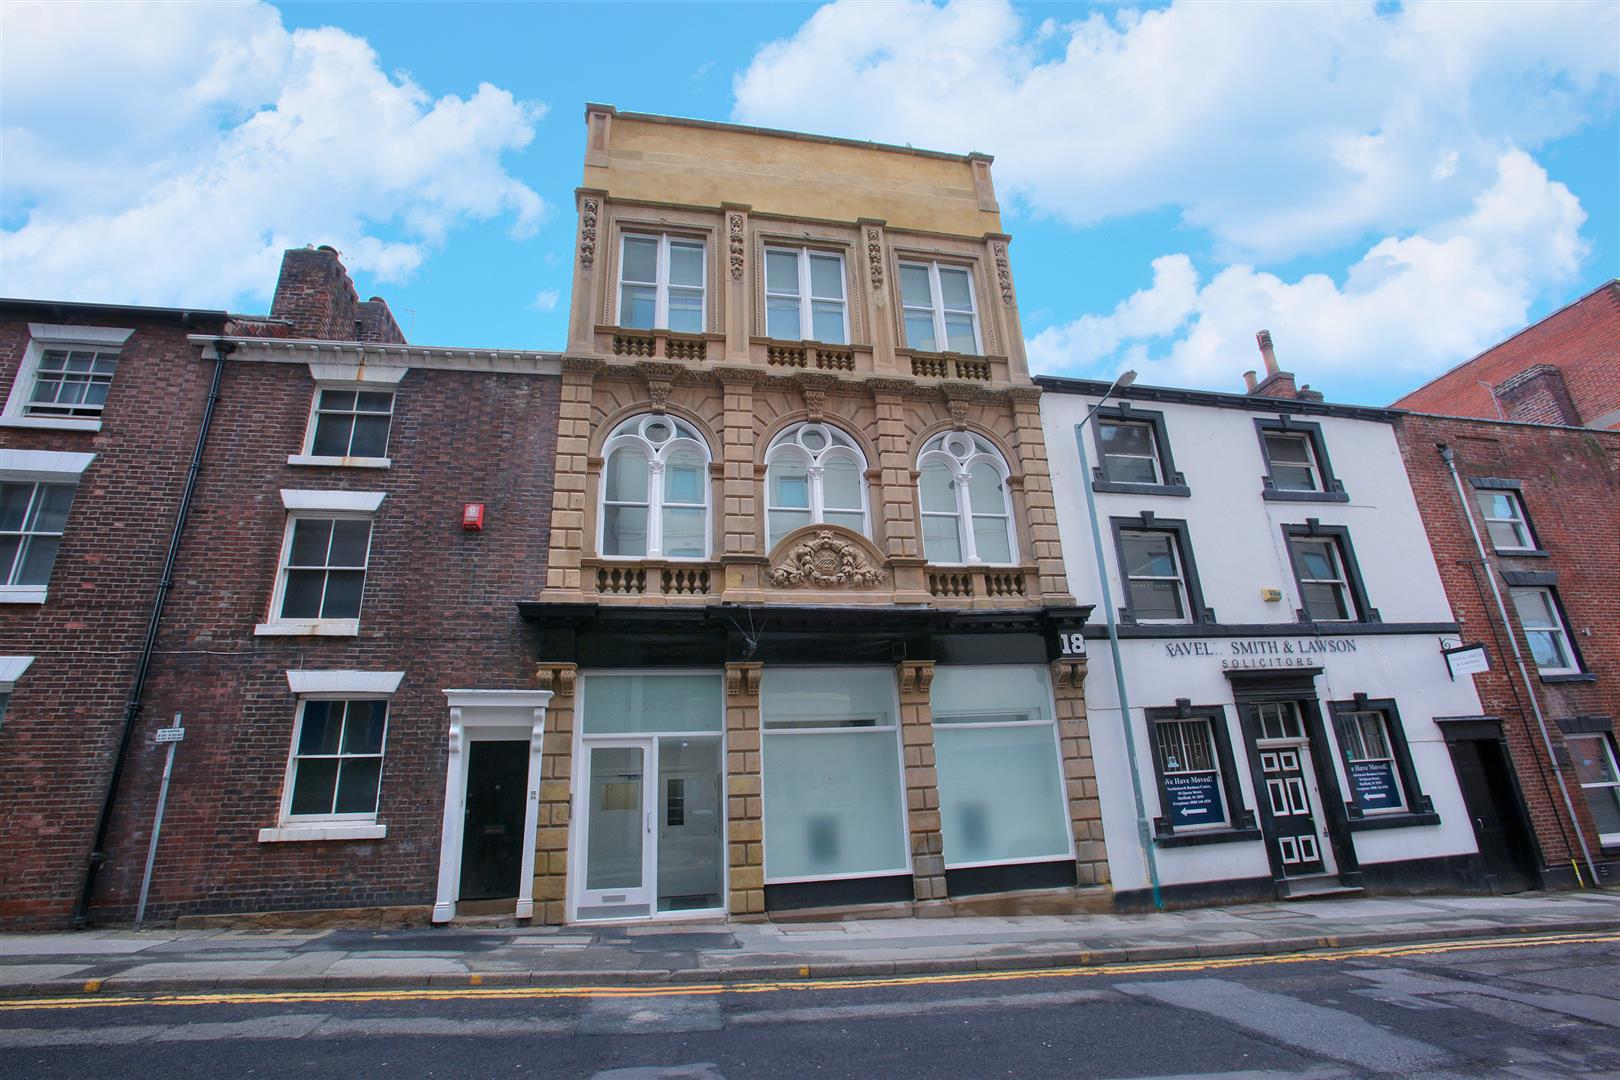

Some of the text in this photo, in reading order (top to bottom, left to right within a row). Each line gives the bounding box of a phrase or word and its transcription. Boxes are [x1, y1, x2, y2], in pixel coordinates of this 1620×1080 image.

[1060, 633, 1086, 654] 18
[1231, 641, 1279, 654] SMITH
[1283, 640, 1294, 654] &
[1298, 639, 1357, 653] LAWSON
[1222, 657, 1313, 669] SOLICITORS
[1174, 777, 1190, 785] Have
